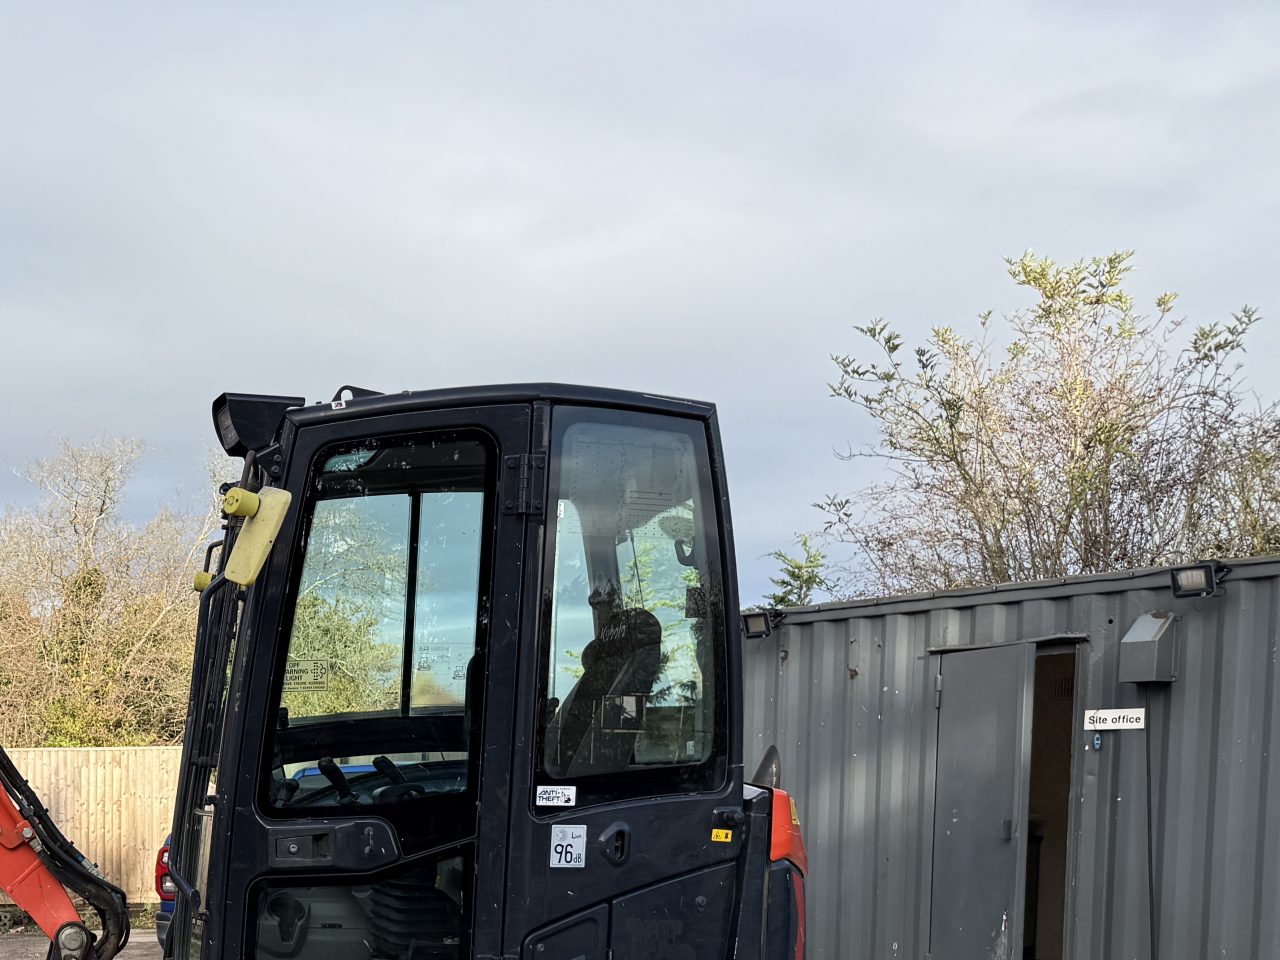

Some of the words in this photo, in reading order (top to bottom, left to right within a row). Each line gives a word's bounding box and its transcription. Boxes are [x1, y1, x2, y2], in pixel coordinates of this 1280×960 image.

[1088, 715, 1107, 724] Site
[1111, 714, 1141, 724] office
[554, 844, 573, 863] 96
[573, 853, 581, 863] dB
